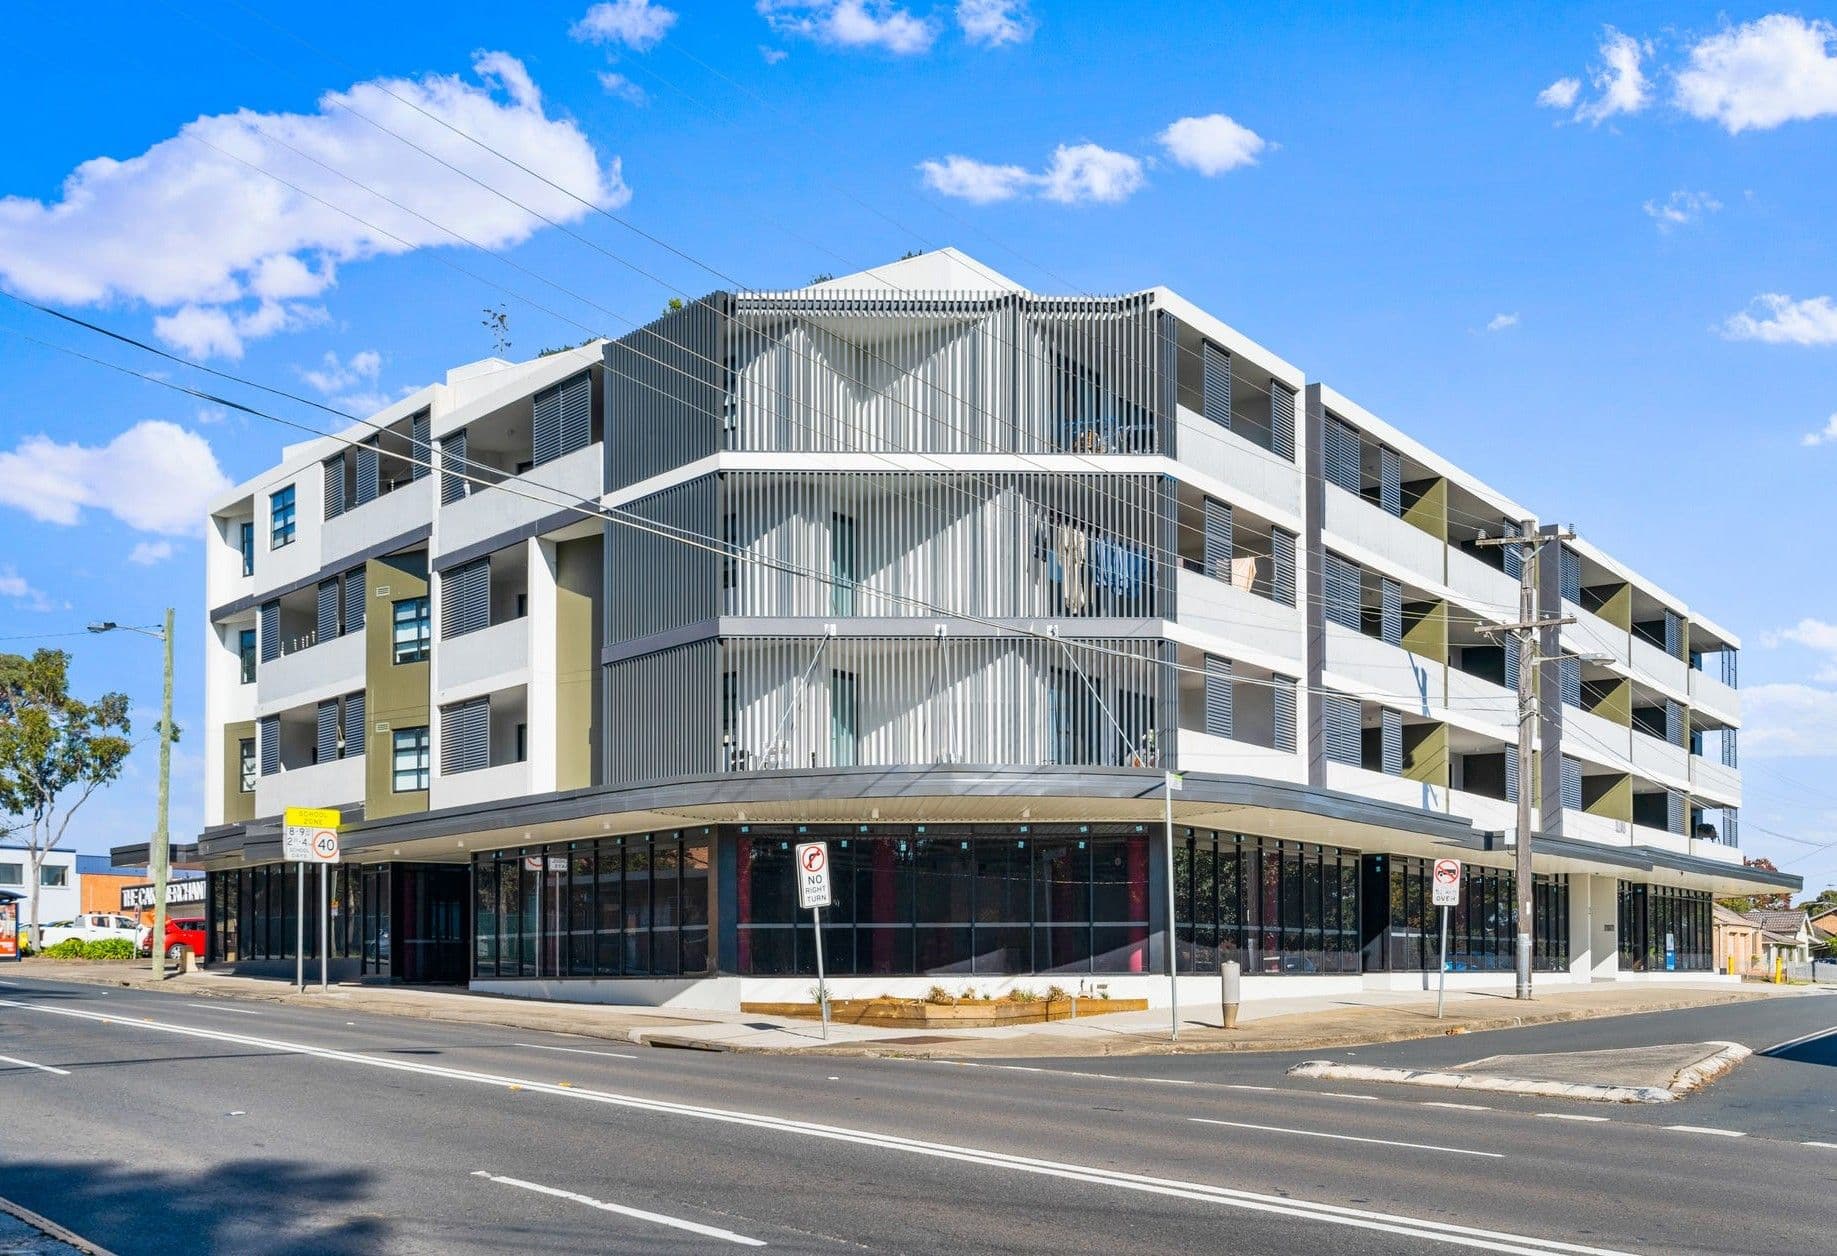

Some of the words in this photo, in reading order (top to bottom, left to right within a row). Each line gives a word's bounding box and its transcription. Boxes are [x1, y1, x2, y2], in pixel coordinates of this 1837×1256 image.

[298, 810, 328, 818] SCHOOL
[318, 839, 334, 851] 40
[808, 874, 823, 885] NO
[805, 886, 826, 895] RIGHT
[807, 895, 827, 903] TURN
